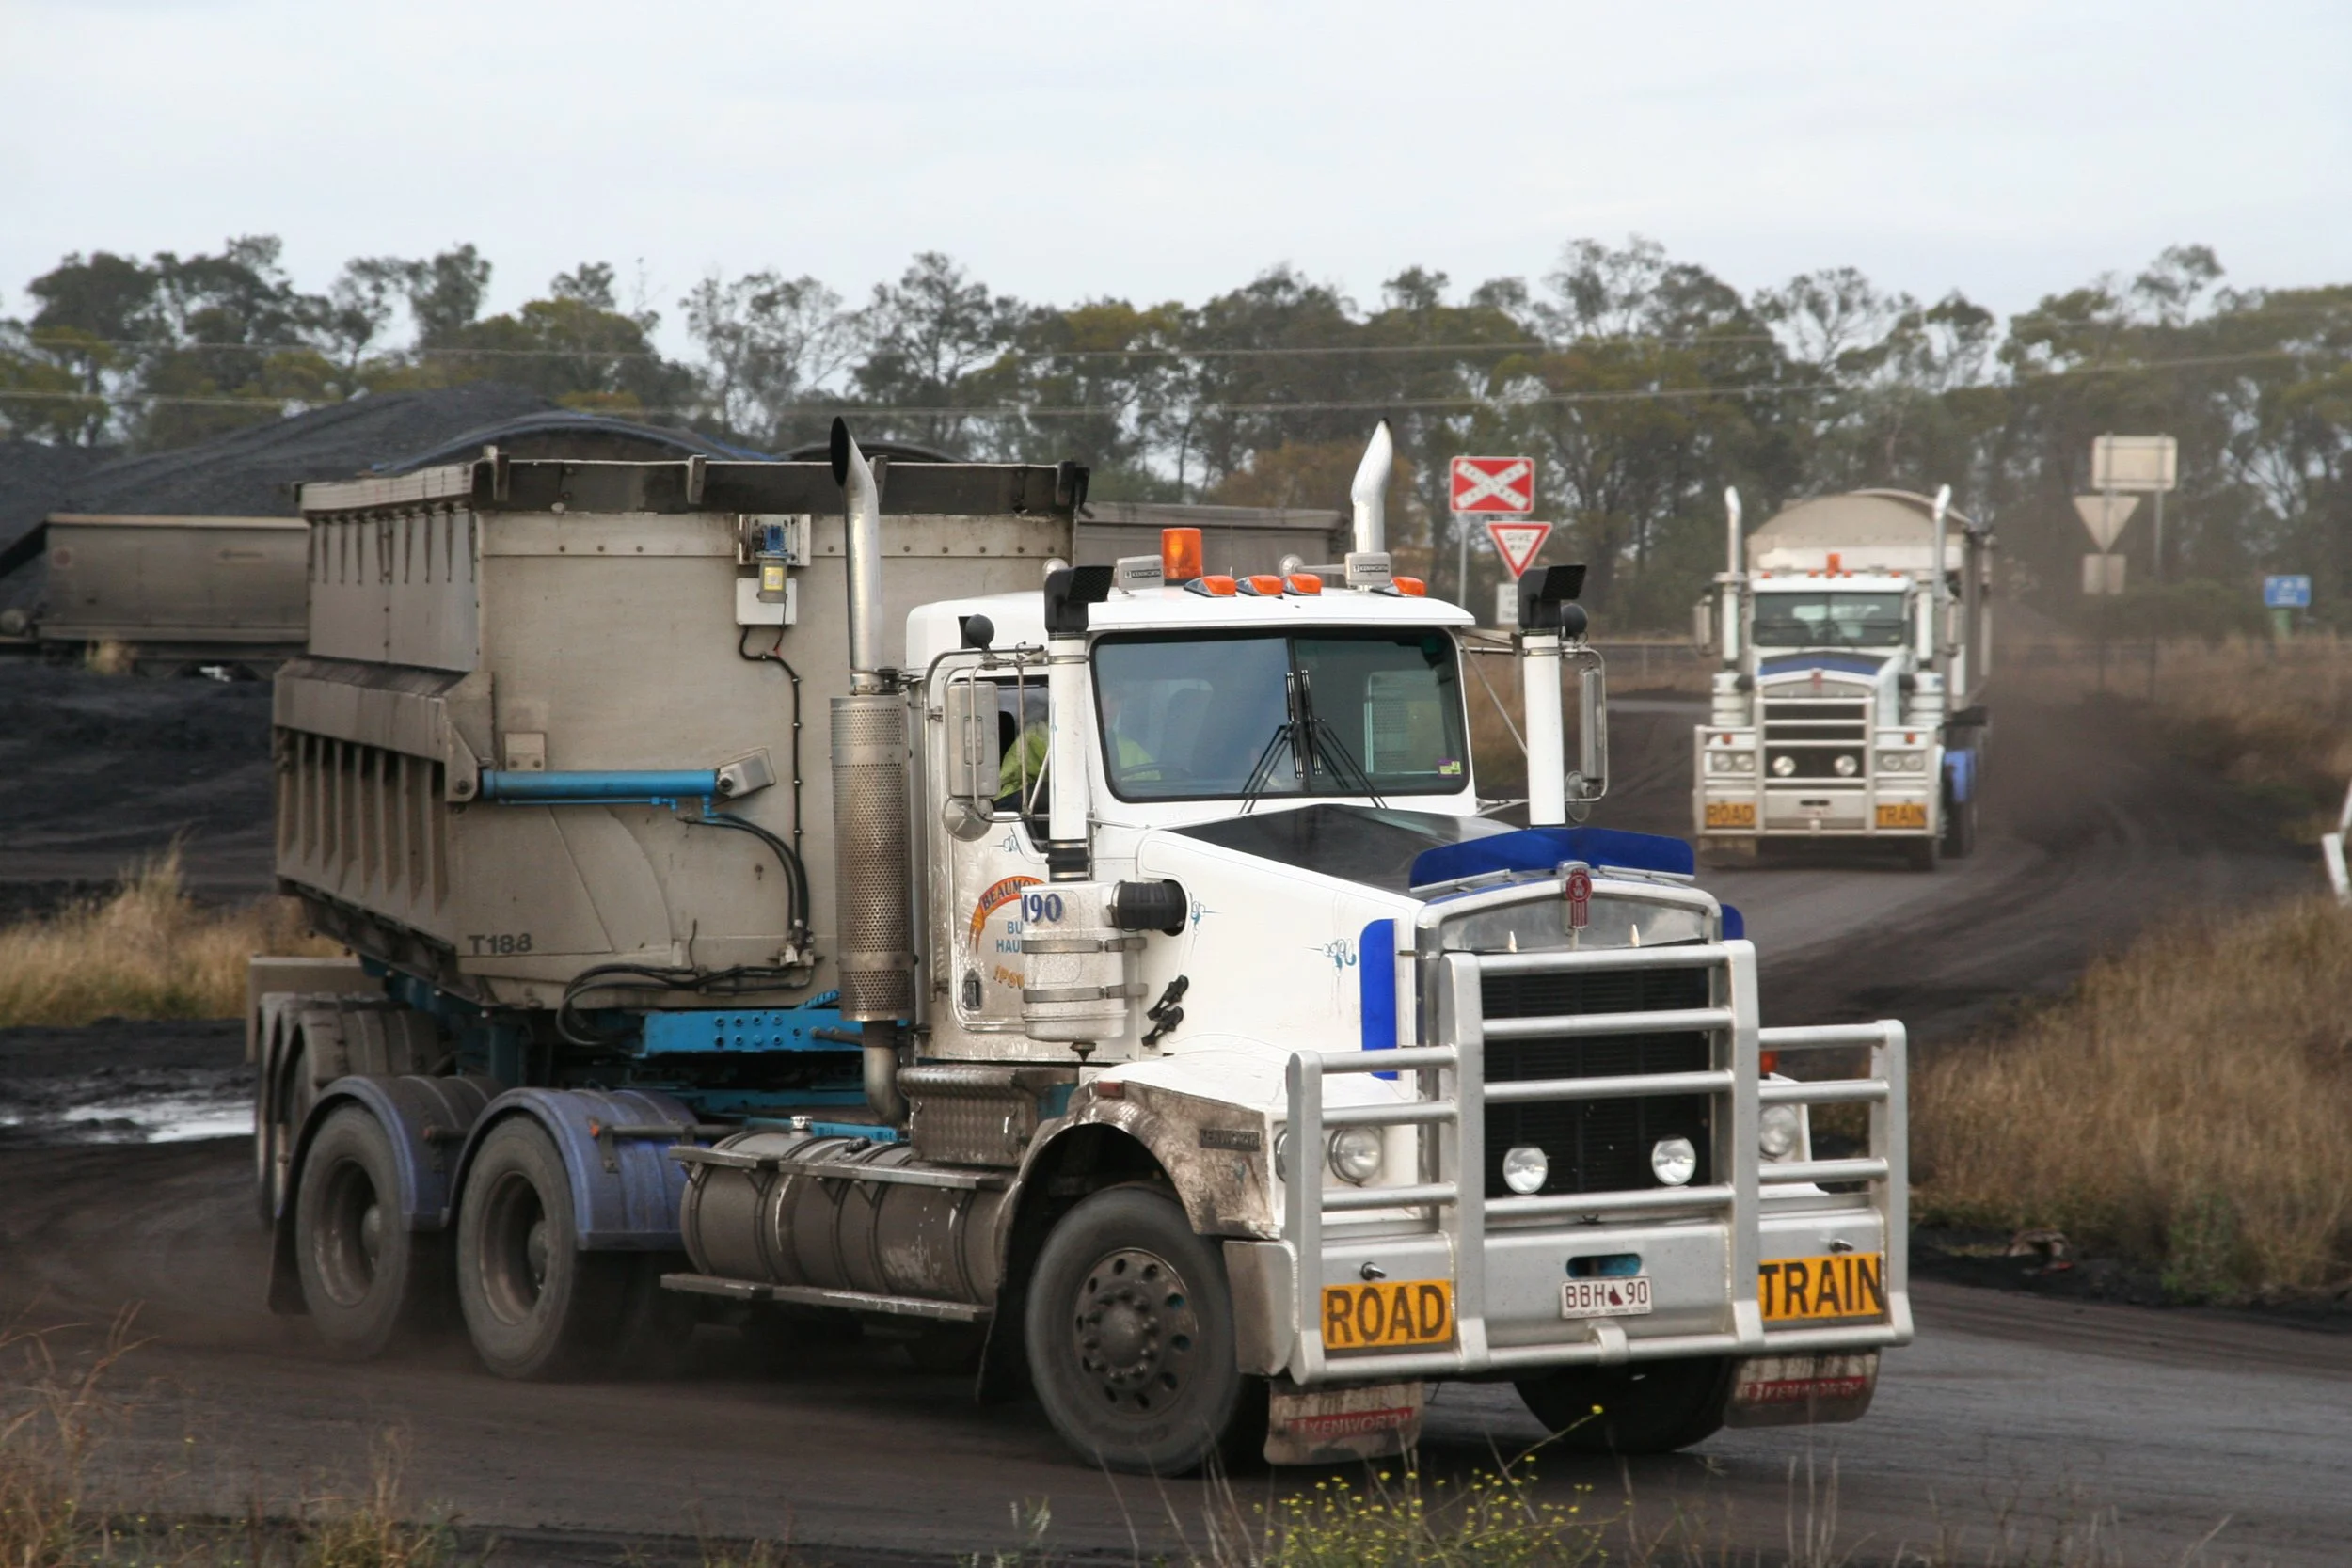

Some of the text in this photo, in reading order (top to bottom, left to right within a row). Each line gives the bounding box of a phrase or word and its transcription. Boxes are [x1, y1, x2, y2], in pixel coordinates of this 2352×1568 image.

[1707, 804, 1753, 824] ROAD
[1007, 921, 1023, 934] BU
[468, 933, 532, 955] T188
[1565, 1281, 1647, 1308] BBH 90
[1758, 1257, 1884, 1316] TRAIN
[1327, 1284, 1445, 1344] ROAD
